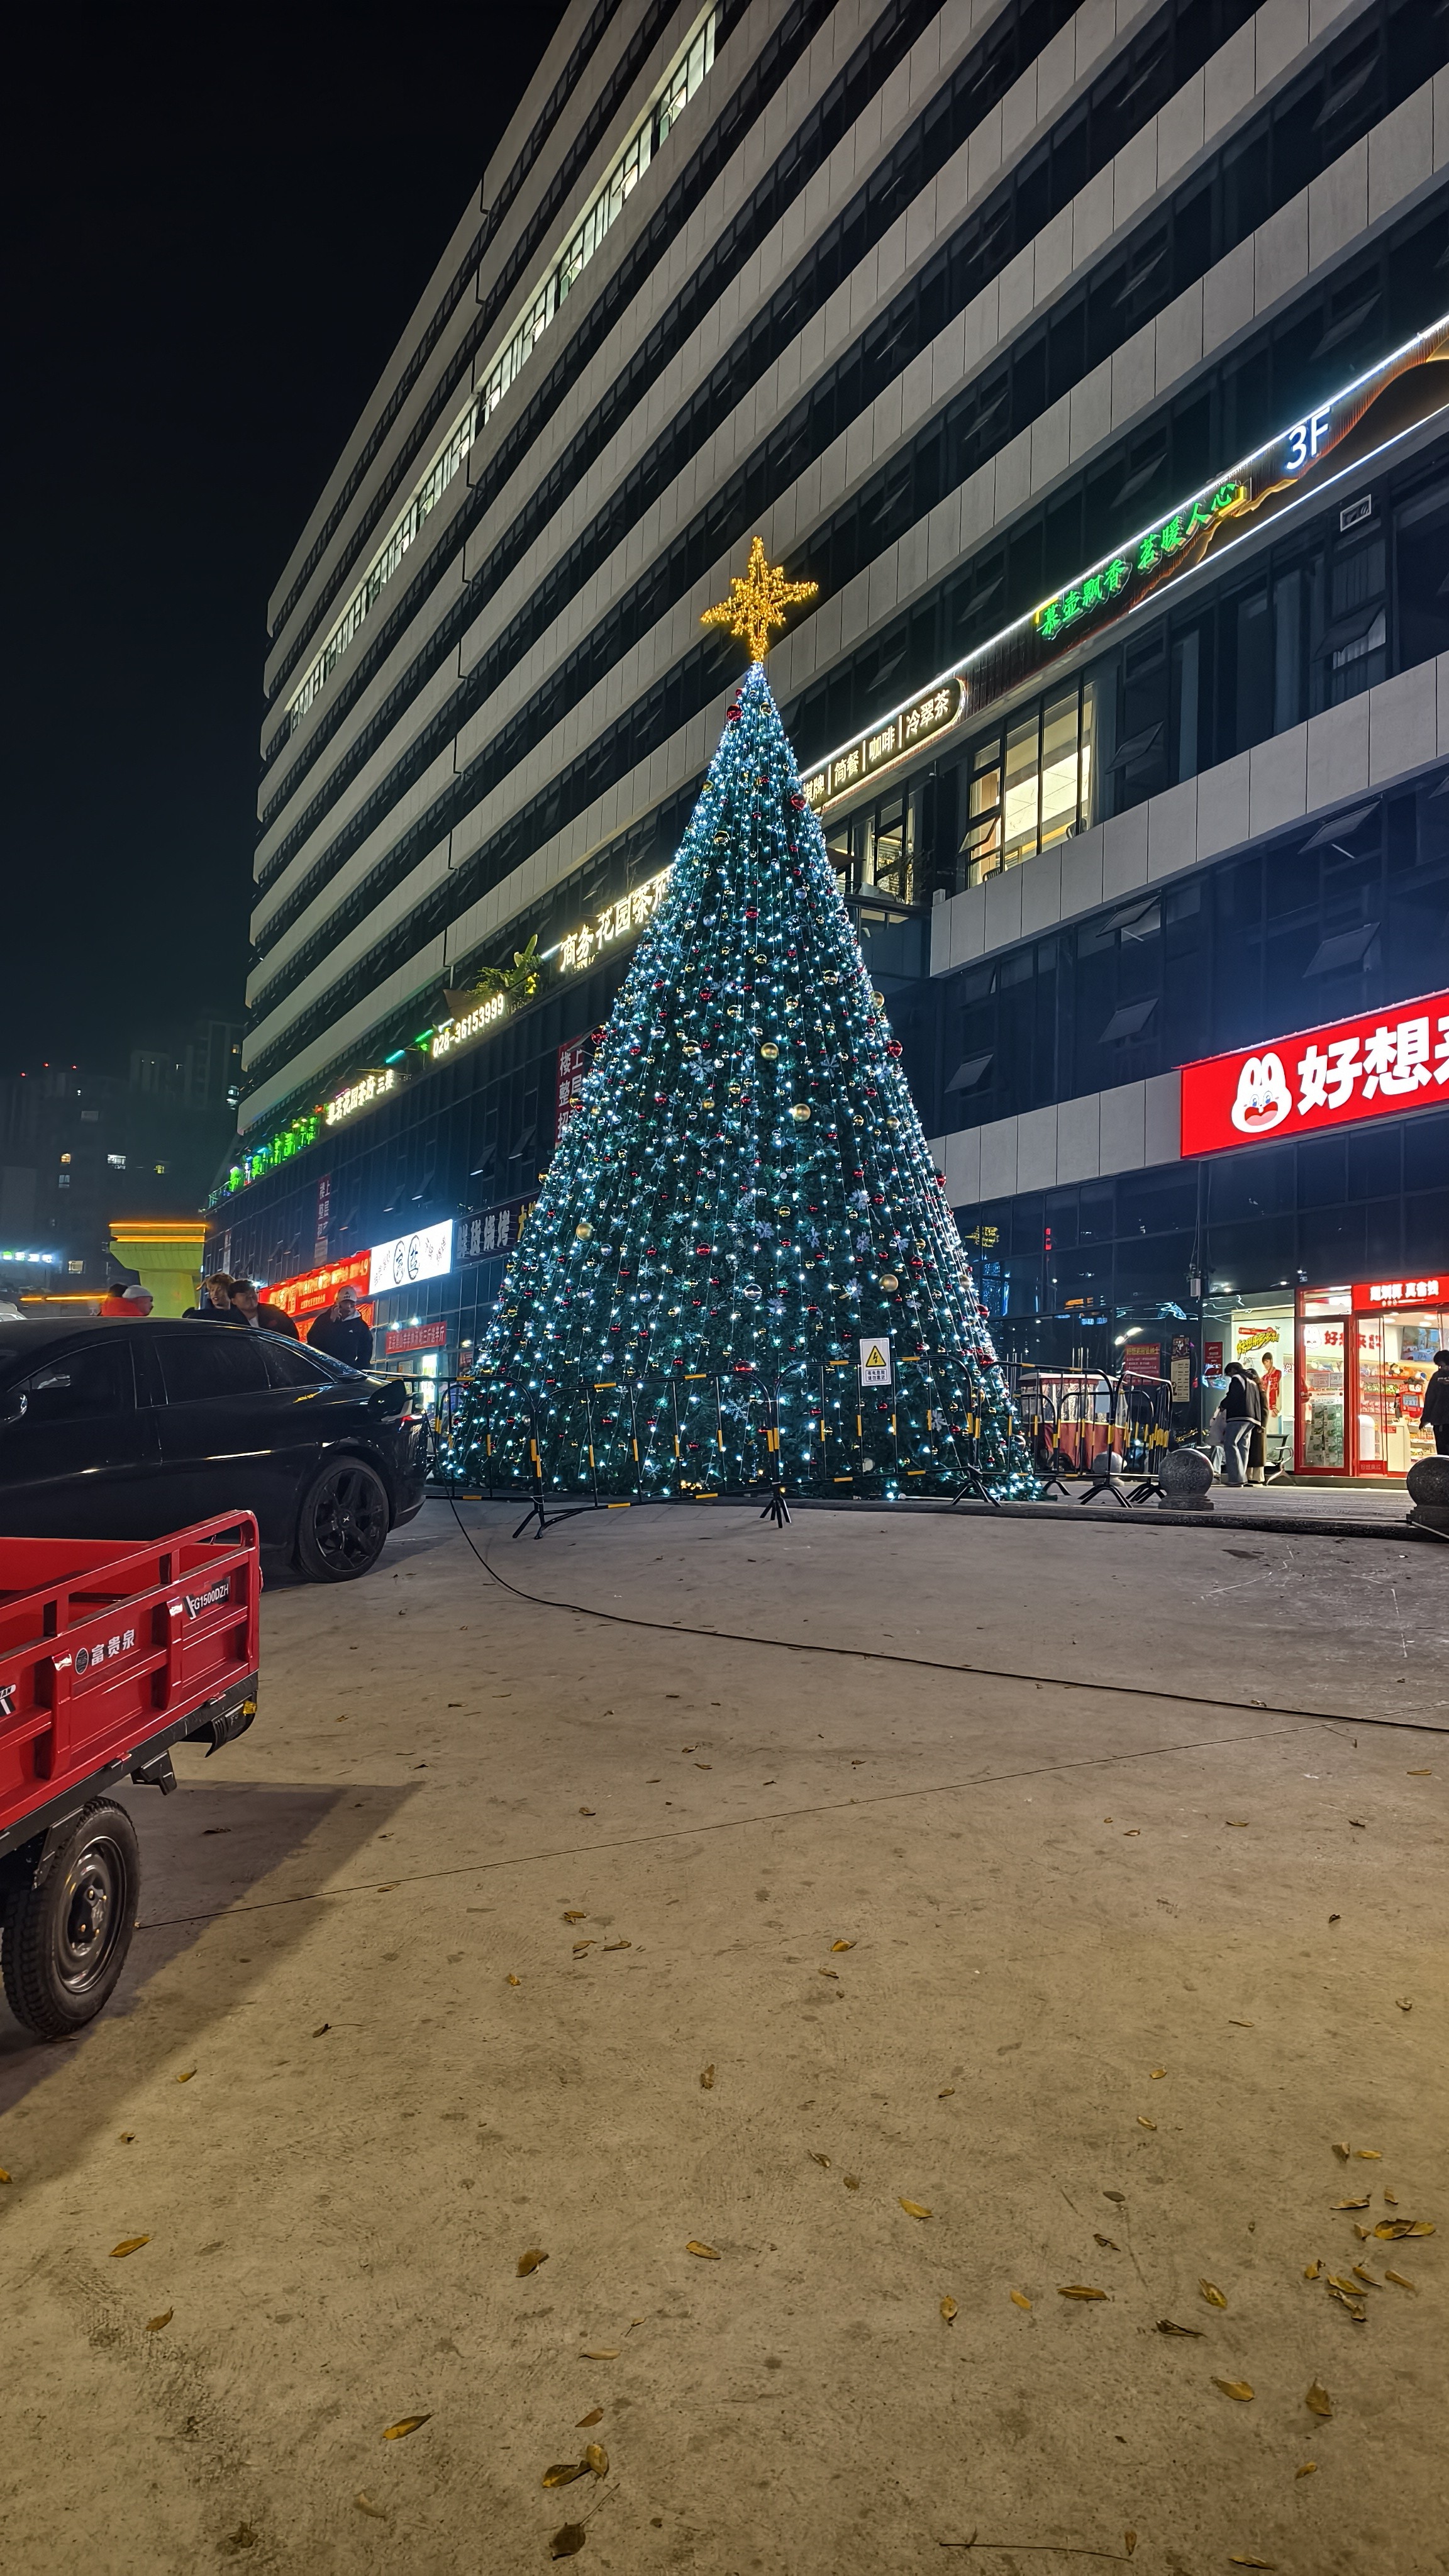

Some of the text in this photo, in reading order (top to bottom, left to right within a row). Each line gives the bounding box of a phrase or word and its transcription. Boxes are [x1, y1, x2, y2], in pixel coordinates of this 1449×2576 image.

[1286, 406, 1330, 469] 3F
[1138, 483, 1236, 569] 茗暖人心
[834, 750, 859, 787] 简餐
[869, 725, 895, 762] 咖啡
[906, 689, 950, 738] 冷翠茶
[432, 993, 504, 1058] 028-36153999
[91, 1628, 135, 1667] 富贵泉
